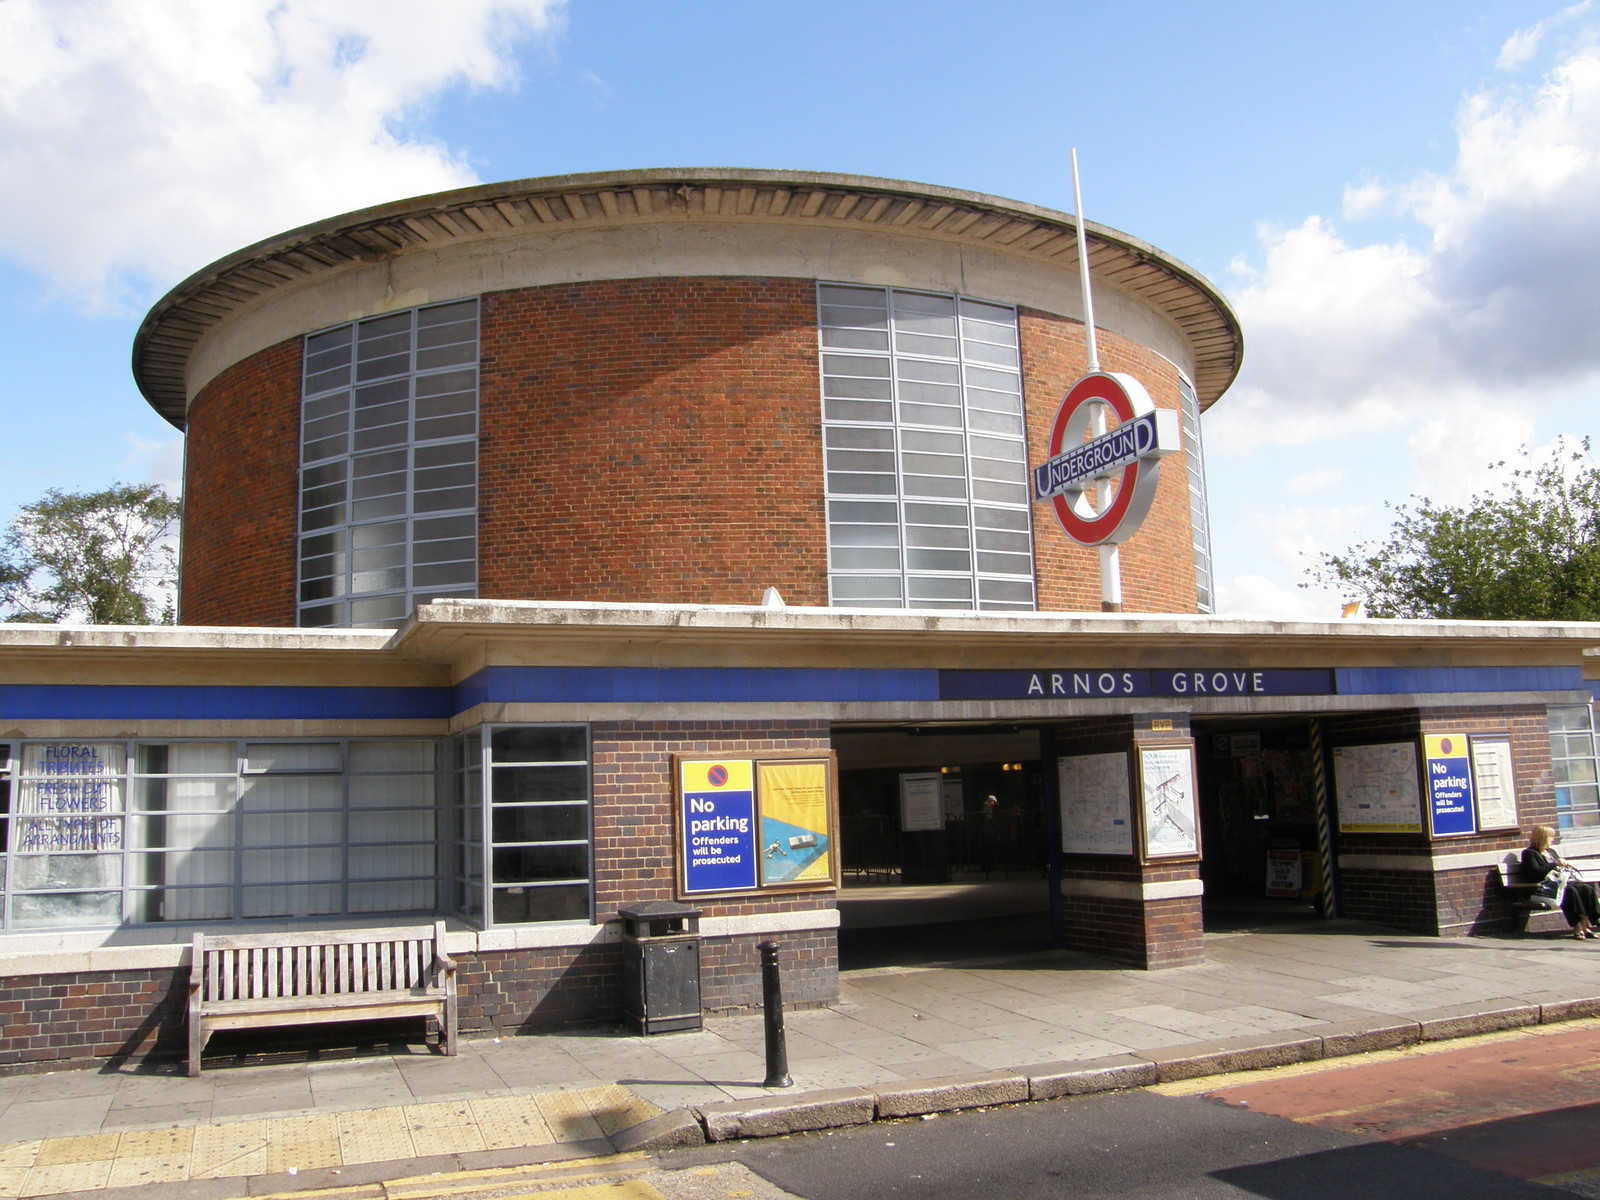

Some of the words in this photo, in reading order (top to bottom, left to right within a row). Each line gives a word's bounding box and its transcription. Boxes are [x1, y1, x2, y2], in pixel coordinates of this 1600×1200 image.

[1036, 418, 1154, 497] UNDERGROUND
[1027, 672, 1134, 695] ARNOS
[1172, 672, 1265, 693] GROVE
[1153, 720, 1171, 730] RVP
[45, 745, 99, 760] FLORAL
[39, 761, 105, 774] TRIBUTES
[1432, 762, 1447, 775] No
[36, 782, 78, 796] FRESH
[82, 781, 110, 795] CUT
[1433, 775, 1468, 791] parking
[1434, 790, 1463, 799] Offenders
[40, 797, 108, 810] FLOWERS
[690, 798, 716, 813] No
[1446, 798, 1453, 806] be
[1436, 805, 1465, 815] prosecuted
[28, 820, 51, 831] ALL
[56, 818, 96, 831] TYPES
[99, 818, 116, 830] OF
[691, 815, 749, 835] parking
[692, 836, 739, 846] Offenders
[692, 846, 708, 856] will
[710, 846, 722, 855] be
[692, 855, 741, 867] prosecuted
